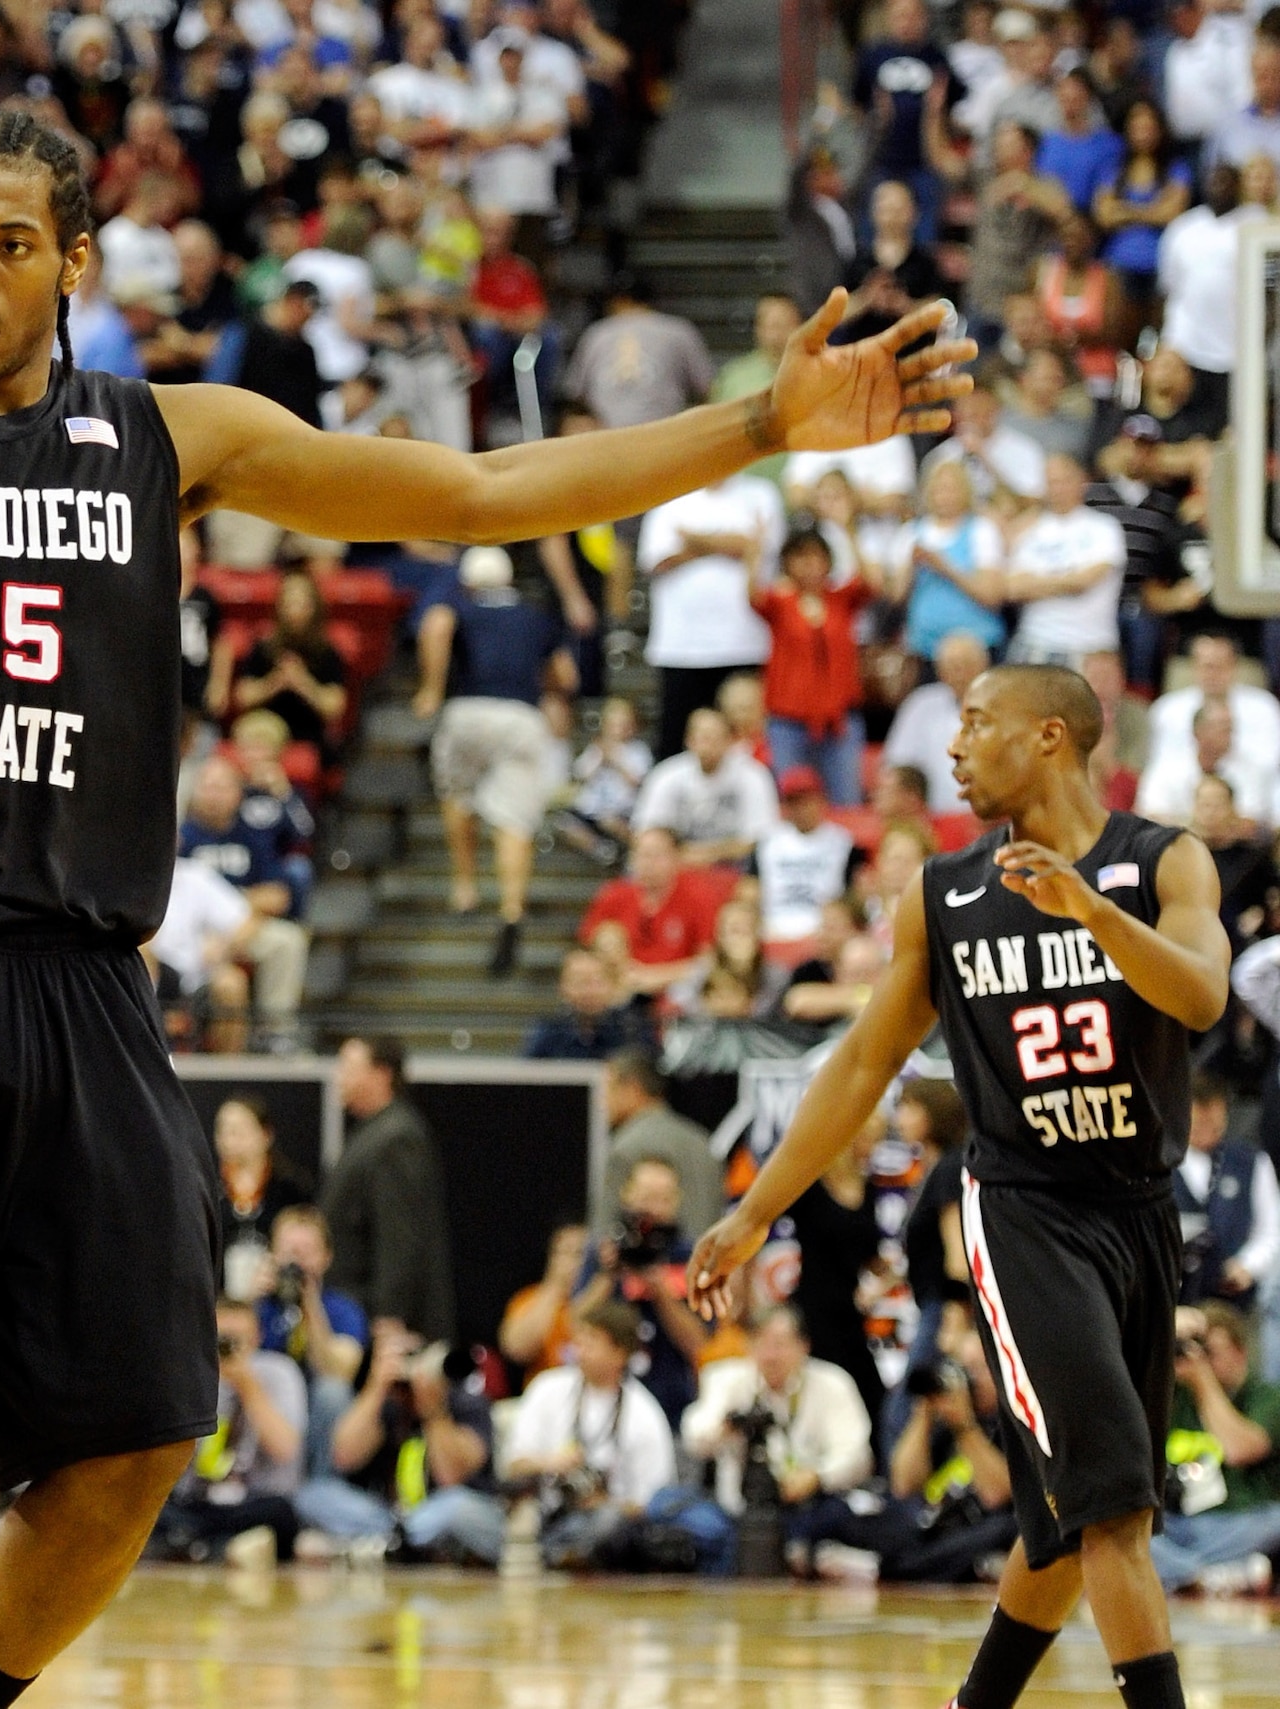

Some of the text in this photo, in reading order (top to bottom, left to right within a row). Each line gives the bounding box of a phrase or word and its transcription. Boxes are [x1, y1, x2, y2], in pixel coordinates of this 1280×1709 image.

[952, 928, 1124, 999] SAN DIE
[1011, 997, 1116, 1083] 23
[1021, 1083, 1138, 1149] STATE
